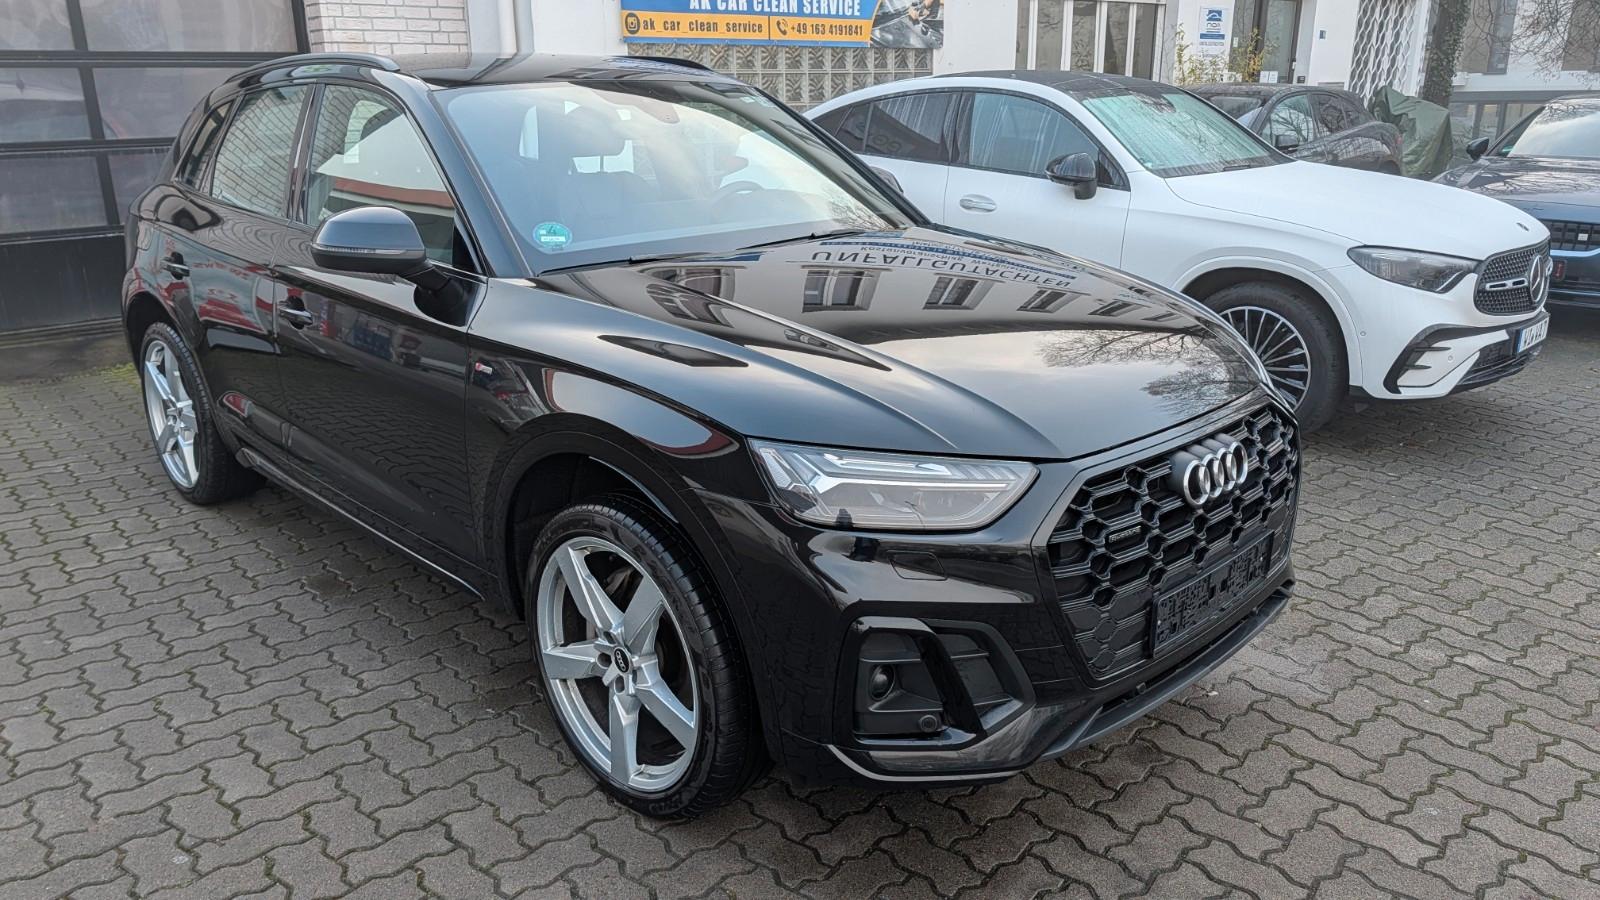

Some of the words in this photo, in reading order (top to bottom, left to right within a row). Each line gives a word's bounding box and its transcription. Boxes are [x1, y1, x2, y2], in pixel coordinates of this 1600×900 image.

[689, 0, 711, 10] AK
[716, 0, 747, 11] CAR
[753, 0, 797, 13] CLEAN
[803, 0, 861, 16] SERVICE
[791, 22, 807, 35] +49
[811, 23, 826, 35] 163
[829, 24, 863, 36] 4191841
